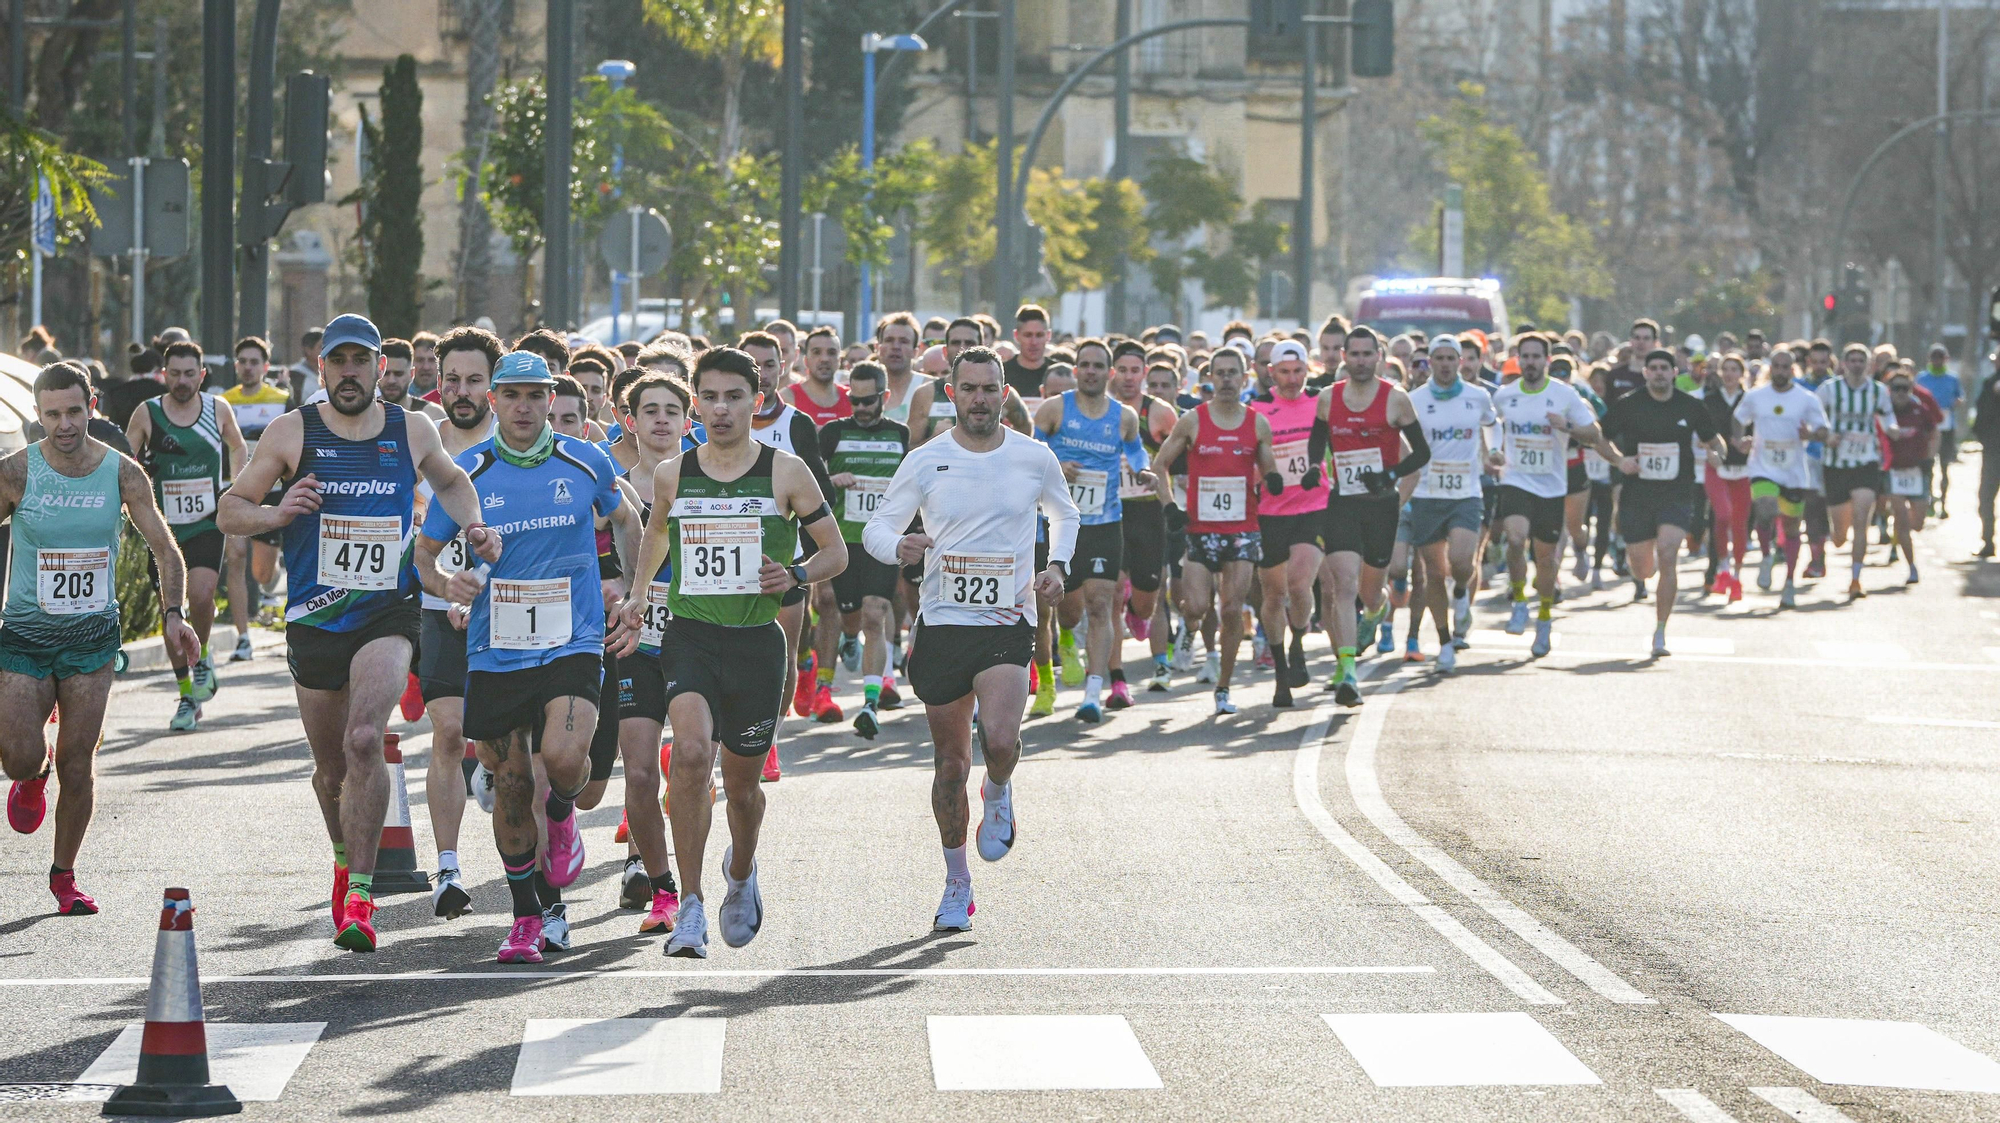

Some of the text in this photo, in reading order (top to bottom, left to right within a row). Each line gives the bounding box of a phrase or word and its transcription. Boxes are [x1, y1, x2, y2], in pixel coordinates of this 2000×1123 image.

[1061, 436, 1116, 453] TROTASIERRA
[1288, 456, 1307, 475] 43
[1520, 450, 1544, 465] 201
[1646, 456, 1671, 472] 467
[315, 479, 396, 497] enerplus
[1438, 474, 1463, 490] 133
[175, 494, 205, 514] 135
[1212, 493, 1232, 511] 49
[323, 518, 351, 540] XLII
[684, 523, 707, 544] XLII
[41, 552, 66, 571] XLII
[334, 542, 385, 574] 479
[694, 545, 741, 578] 351
[943, 554, 967, 575] XLII
[53, 571, 95, 599] 203
[495, 583, 521, 604] XLII
[953, 576, 999, 605] 323
[305, 586, 351, 612] Club Mar
[526, 605, 536, 634] 1
